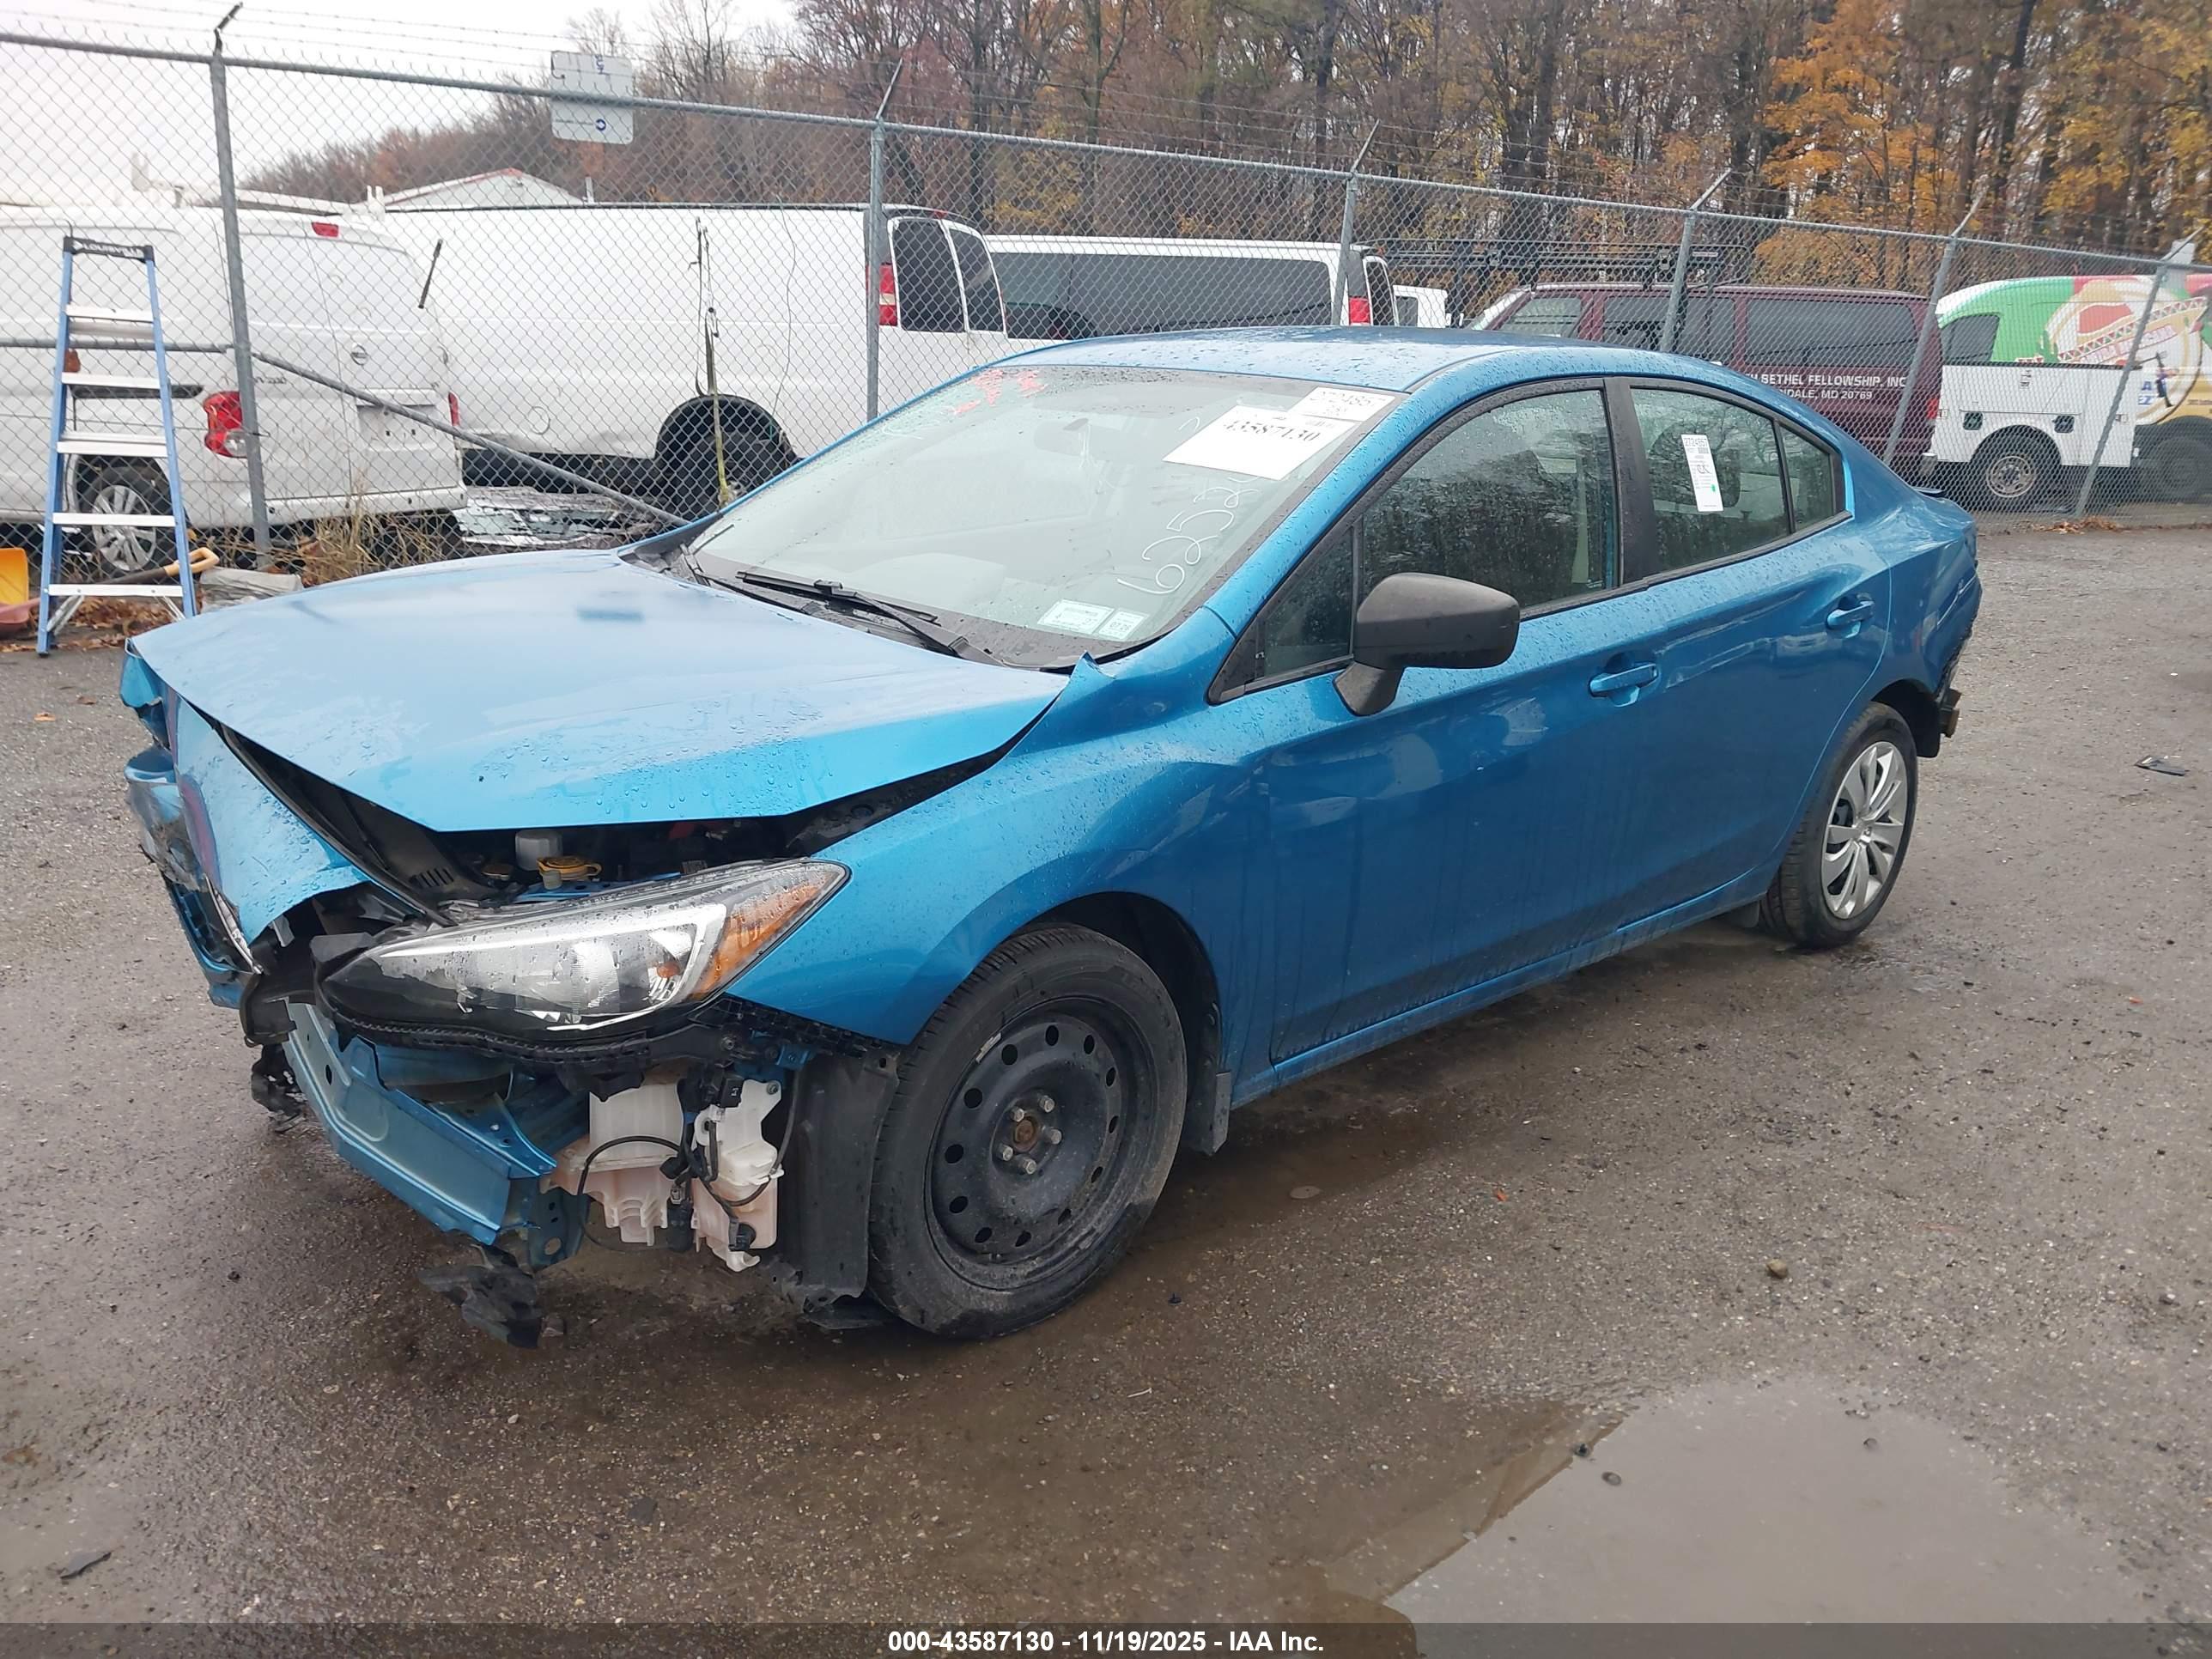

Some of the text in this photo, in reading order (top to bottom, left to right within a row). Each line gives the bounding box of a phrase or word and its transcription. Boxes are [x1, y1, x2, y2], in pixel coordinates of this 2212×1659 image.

[1761, 374, 1804, 385] BETHEL
[1821, 390, 1838, 399] MD
[1841, 391, 1873, 399] 20769
